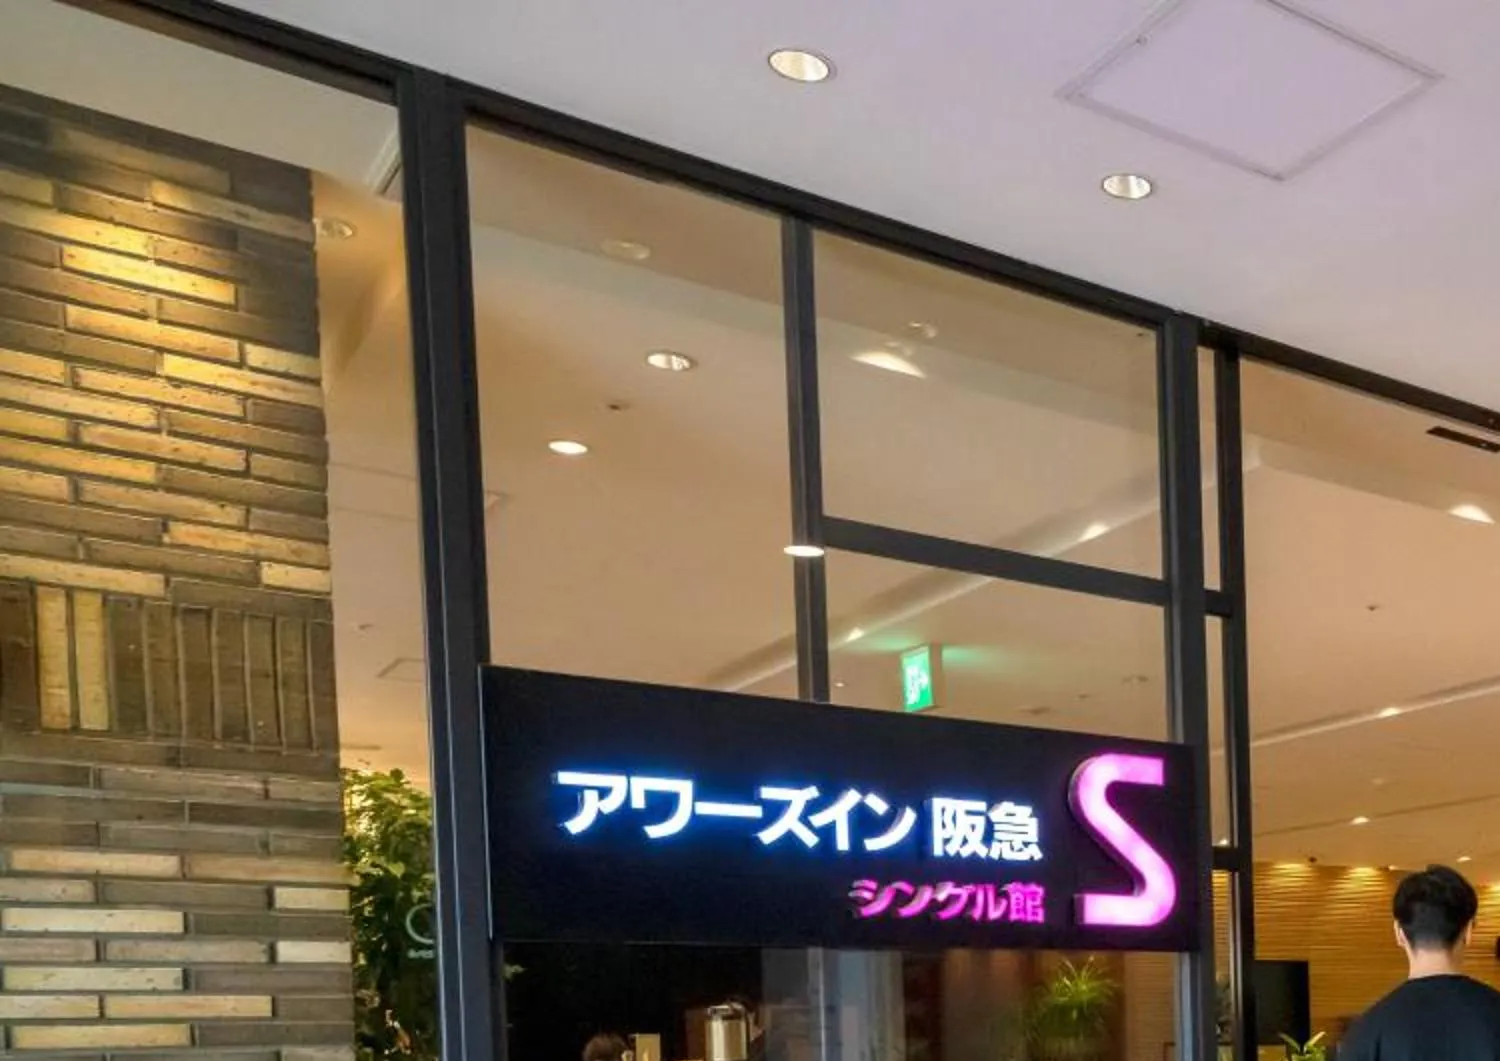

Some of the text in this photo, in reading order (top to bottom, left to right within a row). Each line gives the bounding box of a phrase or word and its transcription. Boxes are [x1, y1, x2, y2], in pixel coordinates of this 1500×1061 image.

[556, 770, 1043, 861] アワーズイン 阪急
[1071, 753, 1176, 927] S
[850, 879, 1045, 924] シングル館
